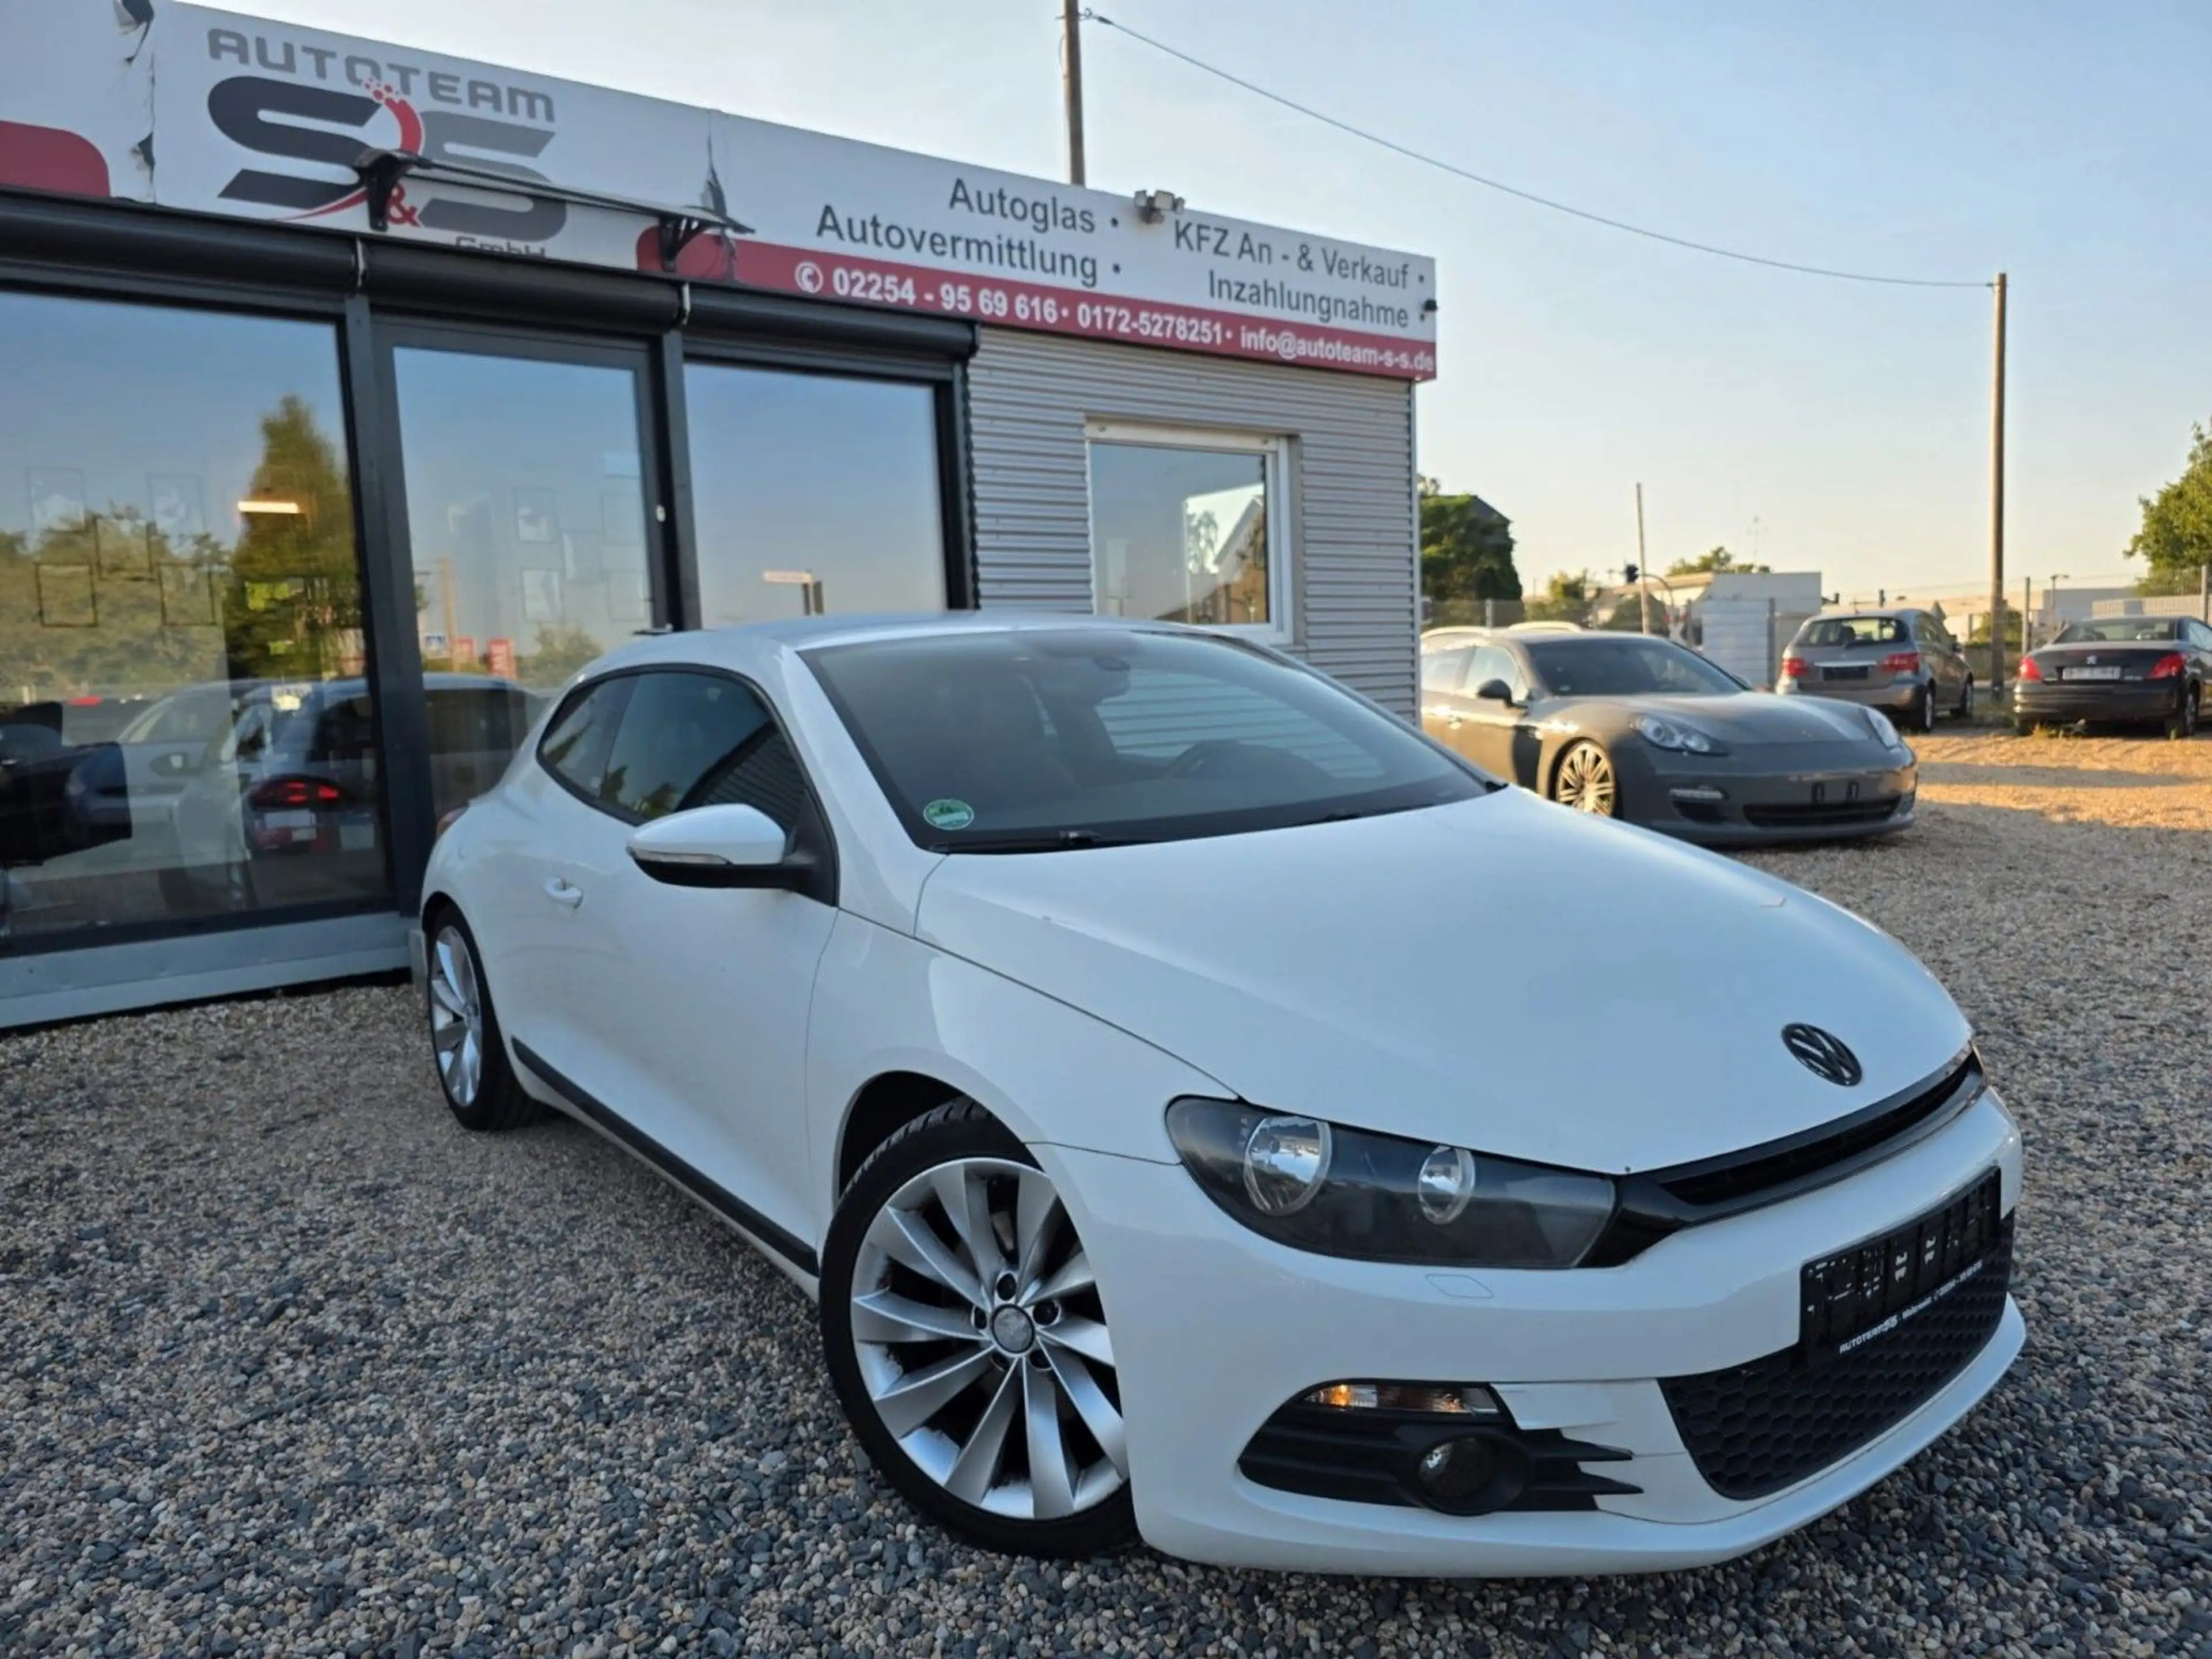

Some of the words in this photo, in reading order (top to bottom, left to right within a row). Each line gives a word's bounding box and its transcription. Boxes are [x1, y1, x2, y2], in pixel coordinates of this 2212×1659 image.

[207, 28, 555, 123] AUTOTEAM
[949, 177, 1095, 234] Autoglas
[816, 204, 1098, 287] Autovermittlung
[1174, 219, 1230, 256] KFZ
[1238, 232, 1272, 266] An
[1297, 243, 1315, 272] &
[1321, 247, 1409, 289] Verkauf
[832, 267, 916, 305] 02254
[940, 282, 971, 312] 95
[979, 290, 1008, 317] 69
[1077, 302, 1222, 345] 0172-5278251
[1240, 325, 1434, 372] info@autoteam-s-s.de
[1209, 270, 1409, 328] Inzahlungnahme
